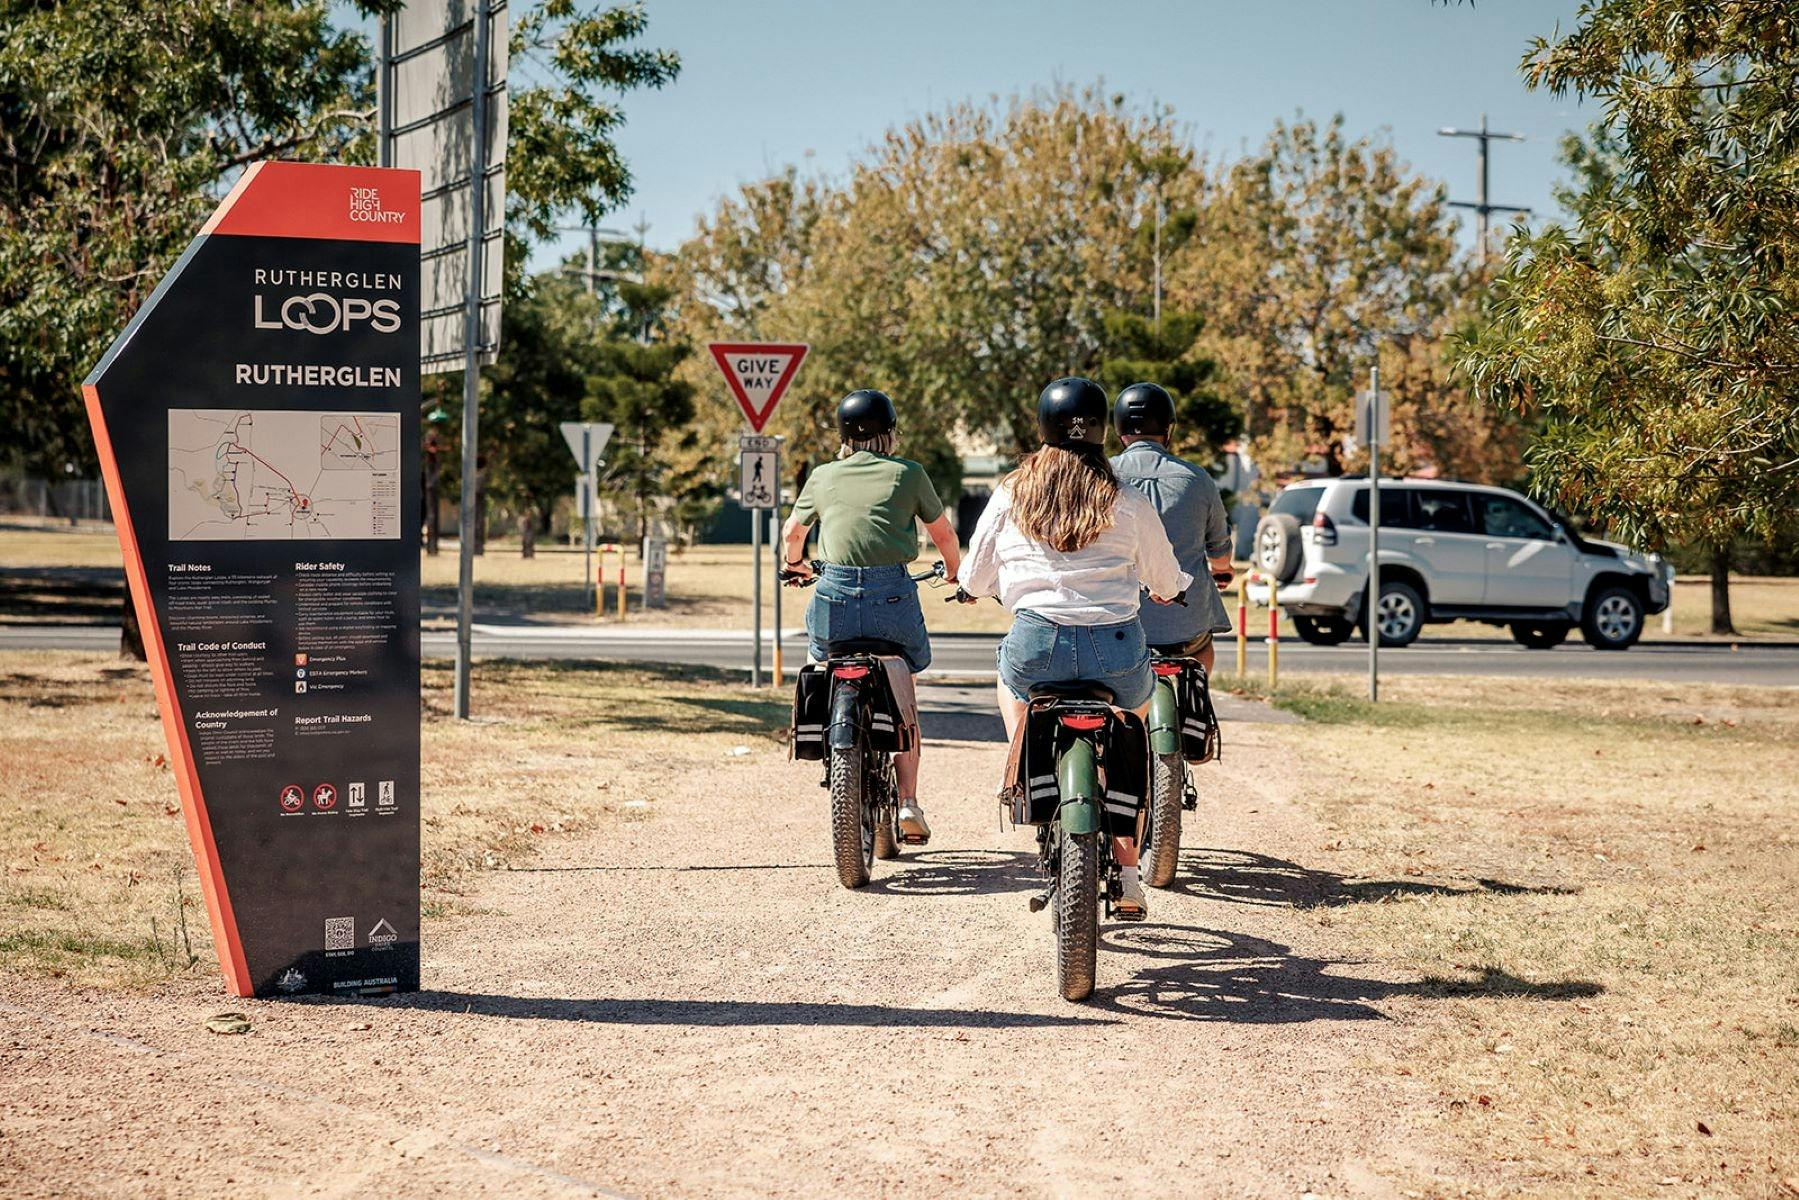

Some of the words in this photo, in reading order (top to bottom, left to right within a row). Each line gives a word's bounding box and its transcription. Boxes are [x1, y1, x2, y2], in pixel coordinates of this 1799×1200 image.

[350, 187, 380, 200] RIDE
[350, 194, 380, 211] HIGH
[350, 209, 406, 224] COUNTRY
[255, 268, 401, 289] RUTHERGLEN
[254, 292, 401, 335] LOOPS
[737, 359, 779, 373] GIVE
[235, 363, 401, 388] RUTHERGLEN
[744, 378, 773, 388] WAY
[748, 440, 770, 448] END
[168, 563, 186, 571] Trail
[188, 563, 211, 571] Notes
[295, 562, 318, 571] Rider
[319, 562, 345, 571] Safety
[177, 643, 196, 651] Trail
[198, 642, 220, 651] Code
[221, 641, 231, 650] of
[232, 641, 266, 650] Conduct
[195, 709, 268, 719] Acknowledgement
[269, 708, 279, 716] of
[195, 721, 228, 729] Country
[295, 716, 321, 725] Report
[323, 715, 340, 723] Trail
[341, 714, 372, 723] Hazards
[369, 934, 398, 943] INDIGO
[333, 980, 362, 988] BUILDING
[363, 977, 398, 986] AUSTRALIA
